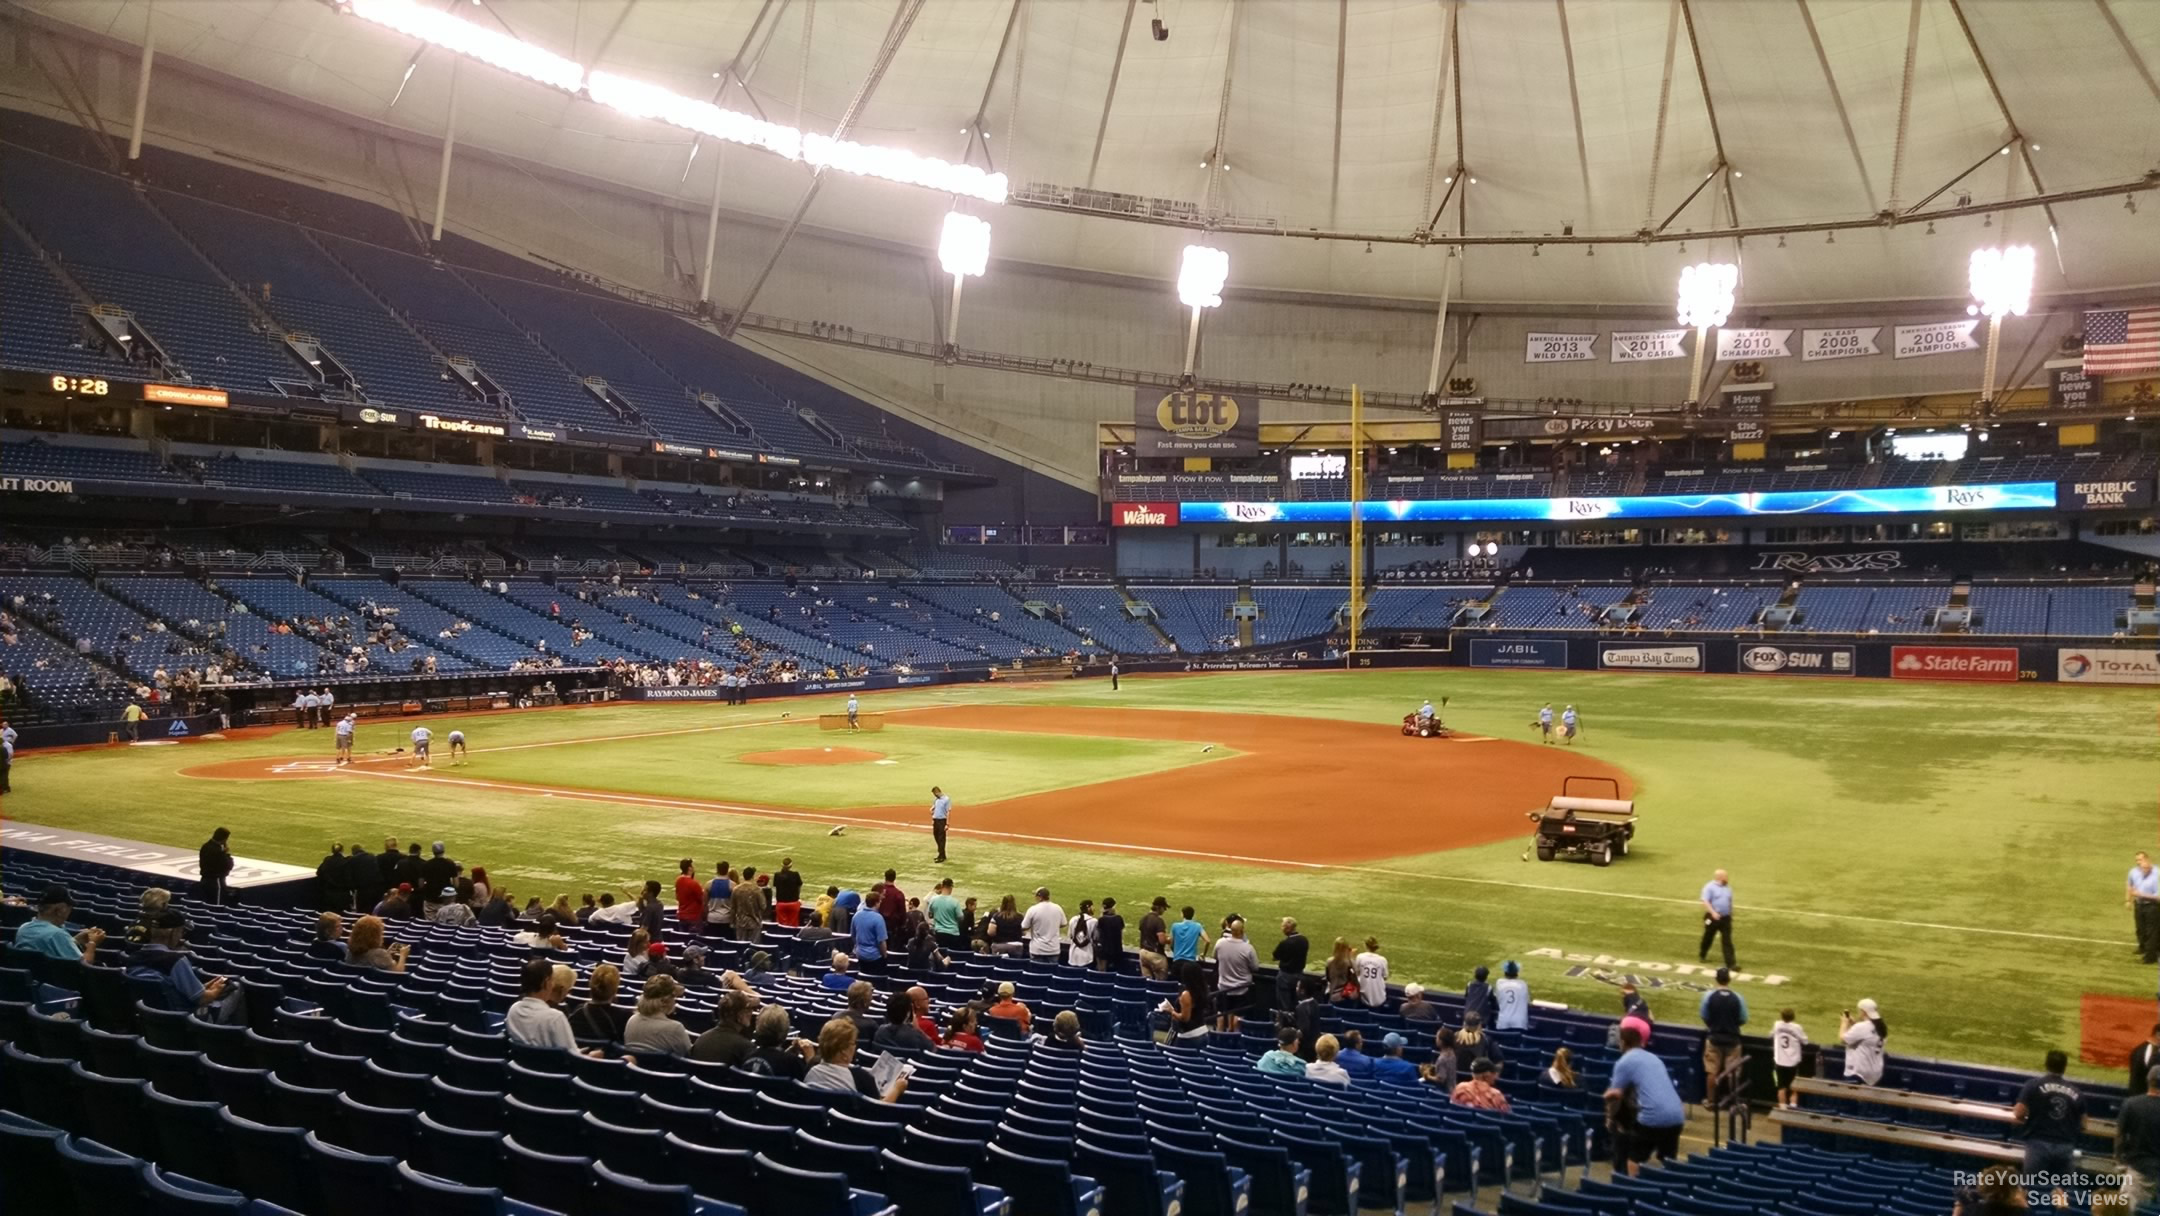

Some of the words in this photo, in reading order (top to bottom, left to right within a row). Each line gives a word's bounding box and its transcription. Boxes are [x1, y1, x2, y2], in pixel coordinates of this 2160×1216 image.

[1734, 338, 1771, 349] 2010
[1820, 336, 1858, 348] 2008
[1914, 330, 1956, 345] 2008
[1544, 342, 1578, 352] 2013
[1630, 340, 1665, 351] 2011
[1808, 346, 1869, 357] CHAMPIONS
[1900, 341, 1966, 354] CHAMPIONS
[1646, 350, 1674, 358] CARD
[1734, 362, 1760, 377] tbt
[52, 376, 108, 396] 6:28
[1450, 378, 1474, 390] tbt
[2058, 382, 2092, 391] news
[1733, 395, 1760, 404] Have
[2064, 392, 2086, 400] you
[1168, 391, 1228, 426] tbt
[380, 412, 396, 422] SUN
[420, 415, 504, 436] Tropicana
[1452, 426, 1470, 434] you
[1571, 418, 1614, 432] Party
[1737, 422, 1757, 430] the
[1730, 429, 1764, 440] buzz?
[1118, 474, 1166, 484] tampabay.com
[1230, 474, 1278, 483] tampabay.com
[0, 478, 20, 490] FT
[24, 478, 72, 493] ROOM
[2074, 482, 2136, 494] REPUBLIC
[2086, 492, 2124, 504] BANK
[1124, 510, 1166, 525] Wawa
[1498, 645, 1538, 654] JABIL
[1608, 652, 1640, 664] Tampa
[1642, 652, 1662, 664] Bay
[1664, 652, 1696, 663] Times
[1754, 652, 1776, 661] FOX
[1788, 652, 1822, 668] SUN
[48, 840, 168, 860] FIELD
[1364, 966, 1377, 979] 39
[1506, 990, 1516, 1004] 3
[1781, 1036, 1790, 1049] 3
[2050, 1096, 2067, 1120] 3
